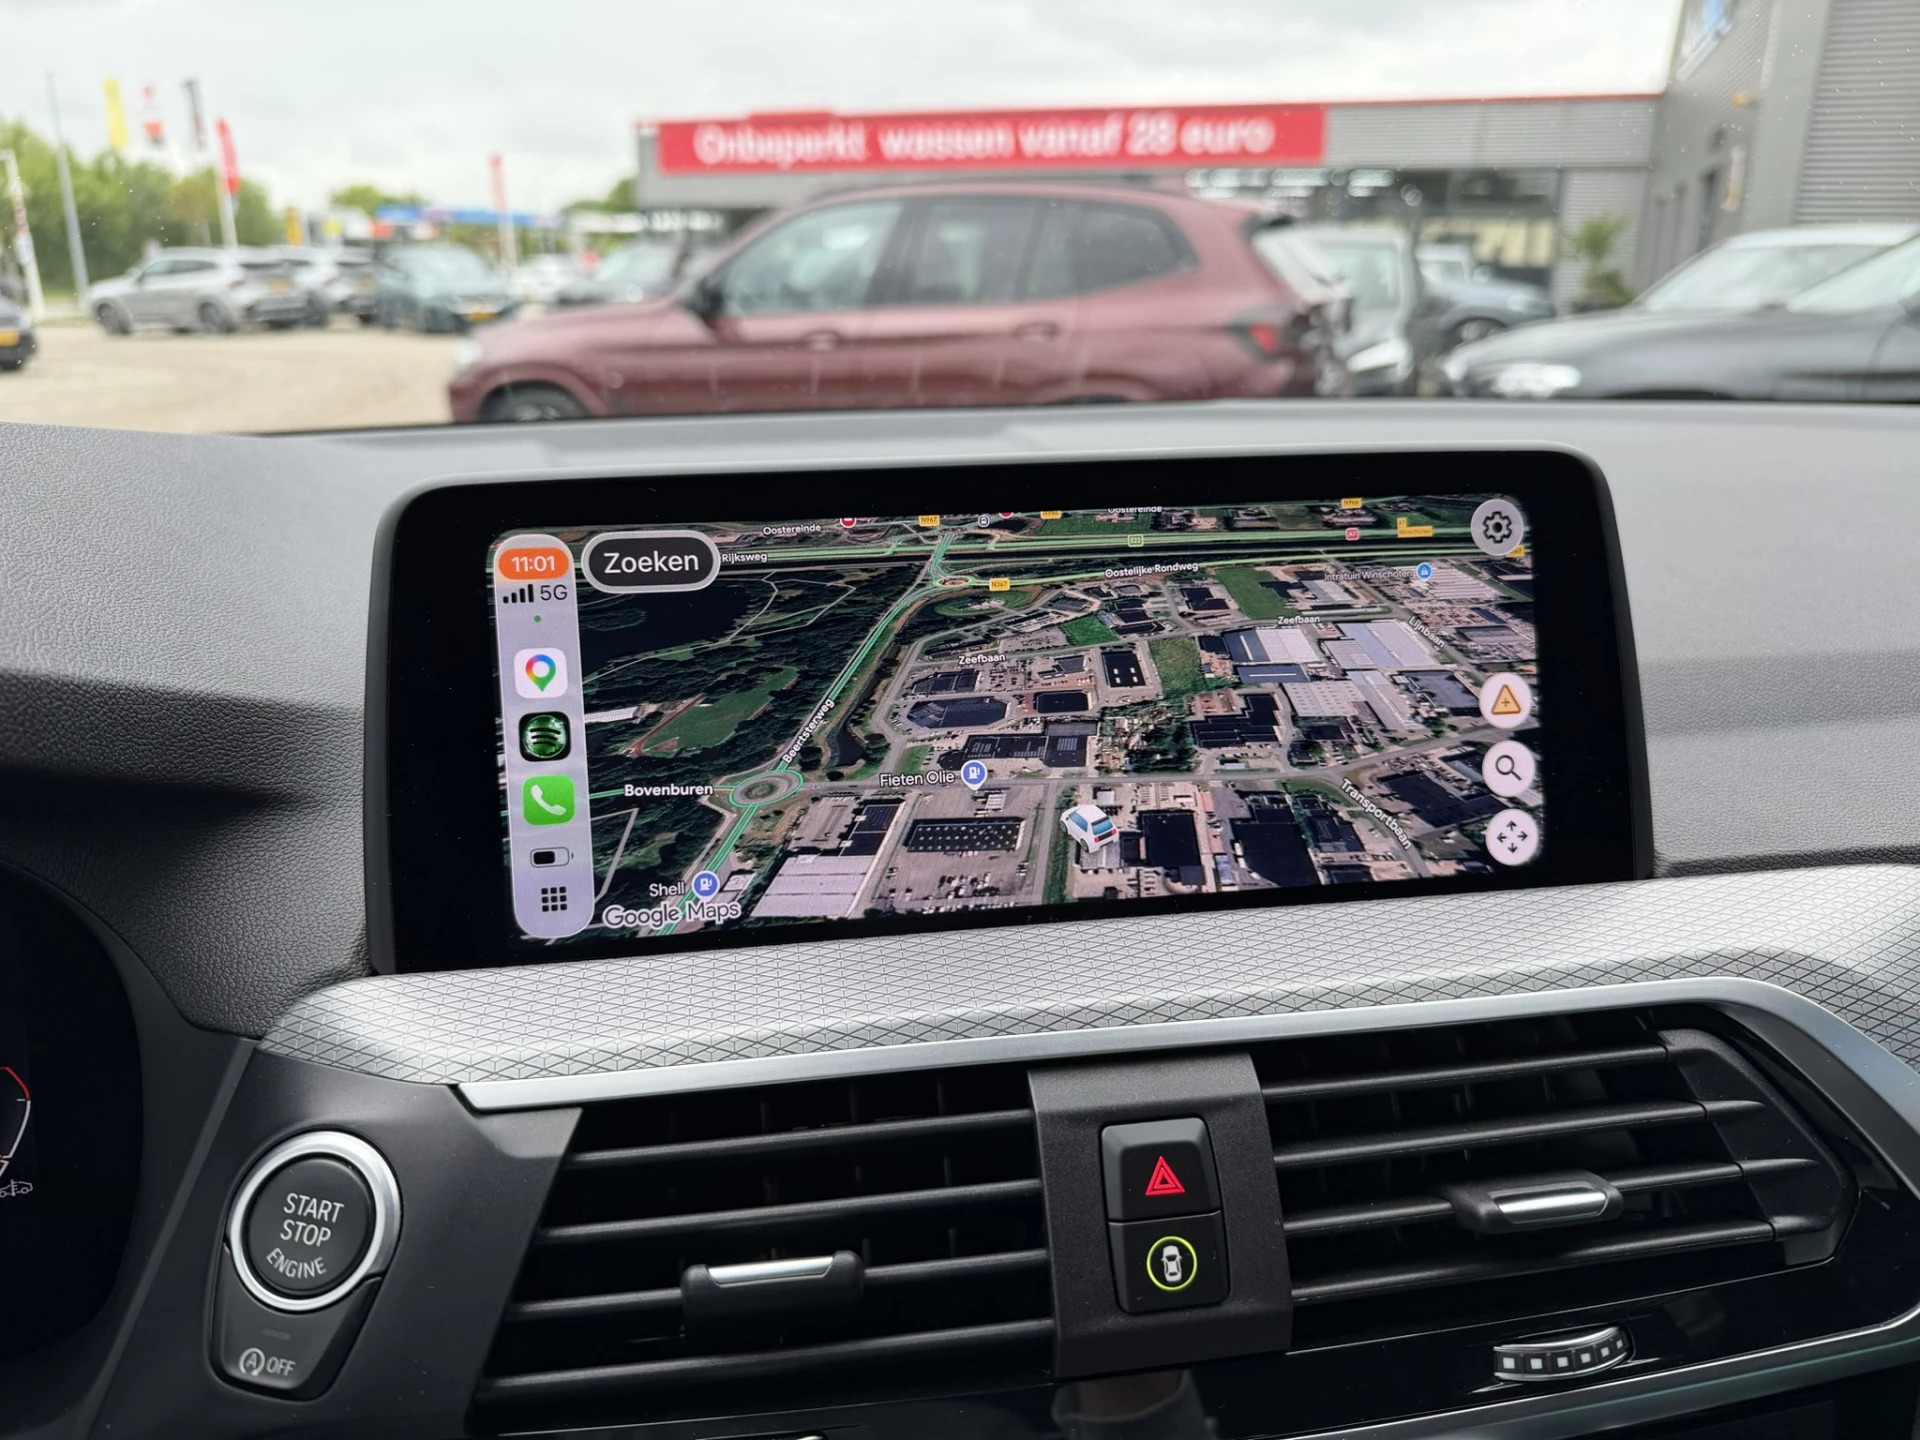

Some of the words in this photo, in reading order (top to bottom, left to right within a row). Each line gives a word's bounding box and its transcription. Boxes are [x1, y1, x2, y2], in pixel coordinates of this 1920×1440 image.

[875, 122, 1014, 161] wassen
[1018, 111, 1124, 158] vanaf
[1180, 116, 1275, 155] euro
[763, 524, 821, 536] Oostereinde
[511, 556, 556, 572] 11:01
[603, 551, 699, 574] Zoeken
[721, 553, 768, 564] Rijksweg
[1105, 566, 1152, 578] Oostelijke
[1154, 563, 1199, 573] Rondweg
[1324, 573, 1360, 581] Intratuin
[1361, 570, 1413, 580] Winschoten
[540, 584, 568, 601] 5G
[1277, 615, 1320, 625] Zeefbaan
[1409, 616, 1445, 648] Lijnbaan
[958, 653, 1006, 665] Zeefbaan
[782, 699, 835, 763] Beertsterweg
[880, 773, 923, 788] Fieten
[925, 770, 955, 785] Olie
[624, 783, 713, 797] Bovenburen
[1341, 778, 1412, 850] Transportbaan
[649, 882, 685, 897] Shell
[603, 904, 681, 928] Google
[687, 902, 740, 923] Maps
[283, 1192, 344, 1223] START
[280, 1219, 331, 1247] STOP
[266, 1247, 327, 1279] ENGINE
[266, 1356, 296, 1376] OFF
